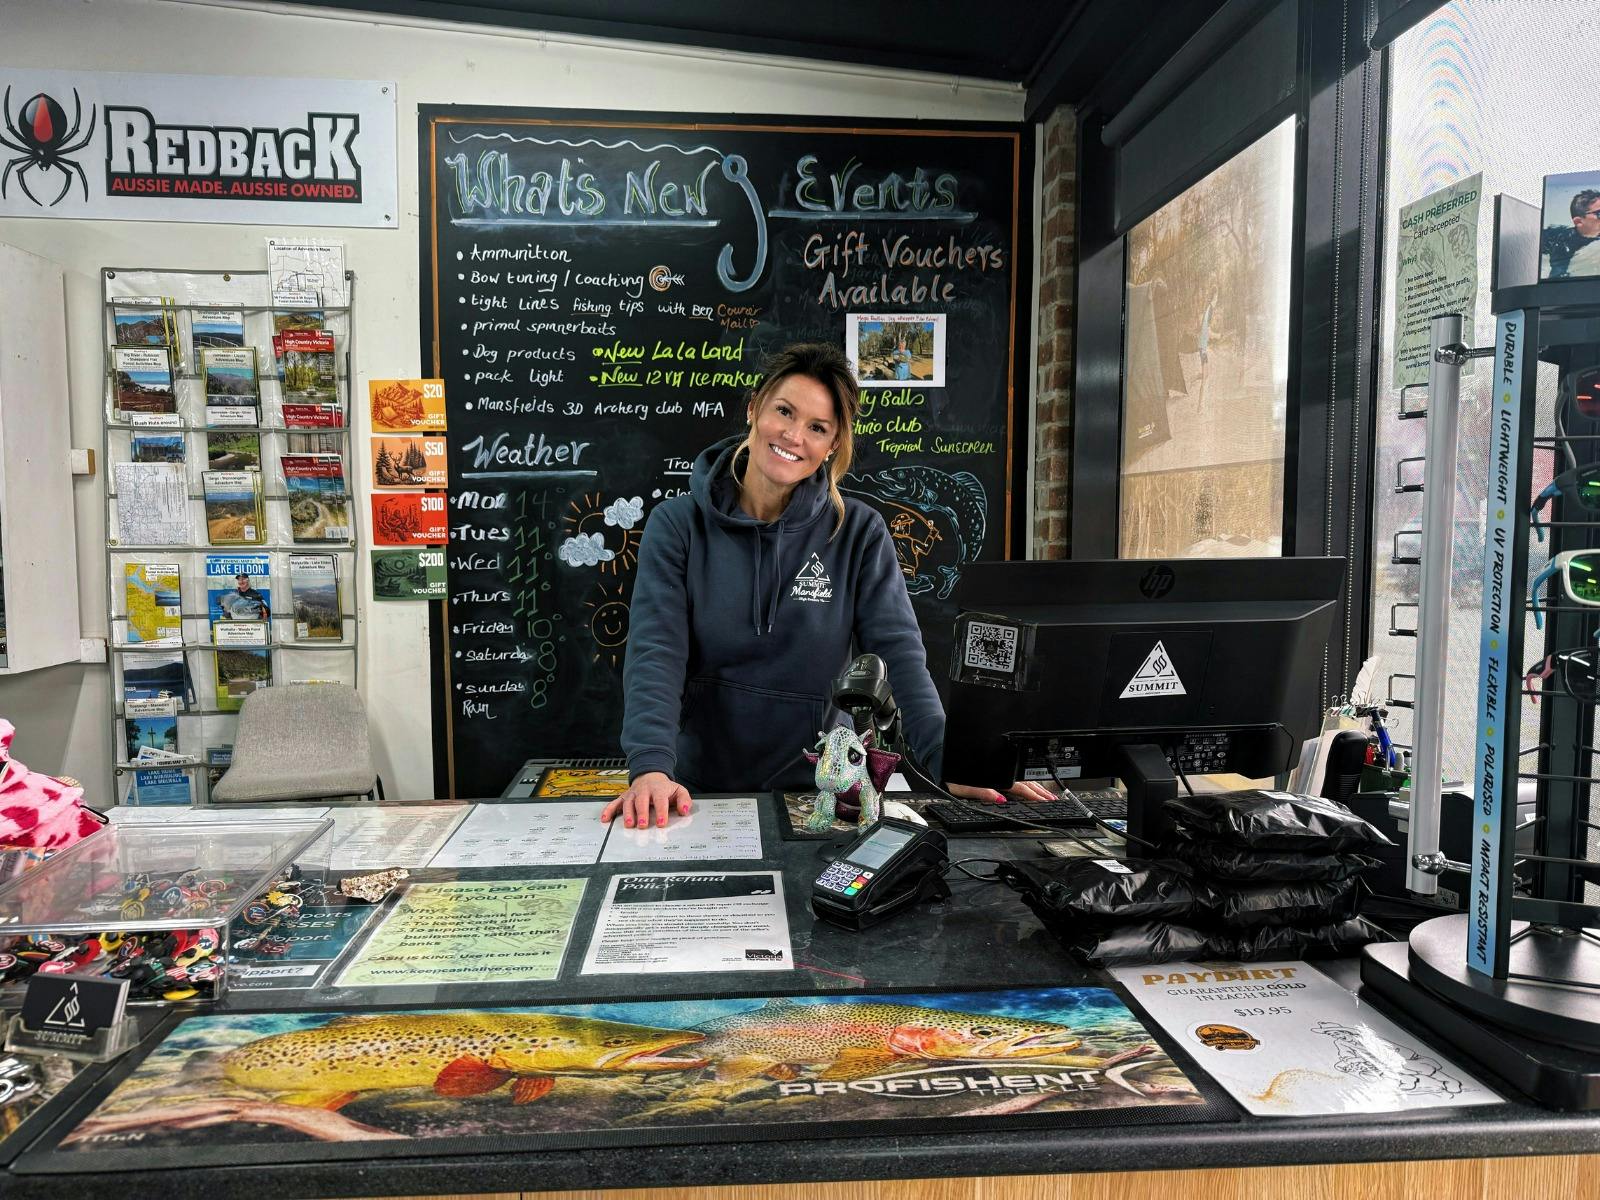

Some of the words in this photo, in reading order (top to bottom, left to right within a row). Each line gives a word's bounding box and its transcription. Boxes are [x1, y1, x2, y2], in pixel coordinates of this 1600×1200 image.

[107, 105, 361, 180] REDBACK
[112, 177, 171, 193] AUSSIE
[174, 179, 228, 195] MADE.
[227, 180, 288, 197] AUSSIE
[290, 182, 359, 199] OWNED.
[444, 150, 606, 216] What's
[624, 160, 720, 216] New
[795, 155, 959, 212] Events
[1402, 213, 1424, 230] CASH
[1424, 190, 1478, 222] PREFERRED
[1413, 225, 1429, 241] Card
[1429, 214, 1461, 234] accepted
[470, 243, 572, 263] Ammunition
[803, 230, 869, 278] Gift
[882, 234, 1005, 271] Vouchers
[470, 270, 500, 284] Bow
[507, 270, 558, 293] tuning
[818, 271, 957, 308] Available
[573, 297, 612, 318] fishing
[619, 299, 644, 318] tips
[658, 302, 686, 317] with
[692, 304, 714, 321] Ben
[473, 319, 521, 337] primal
[527, 321, 617, 336] spinnerbaits
[472, 343, 499, 363] Dog
[506, 347, 576, 363] products
[604, 340, 645, 363] New
[701, 337, 744, 361] Land
[1503, 321, 1517, 386] DURABLE
[475, 369, 514, 385] pack
[601, 366, 638, 385] New
[423, 383, 443, 399] $20
[477, 395, 555, 414] Mansfields
[562, 402, 584, 416] 3D
[594, 401, 649, 421] Archery
[655, 400, 683, 414] club
[692, 401, 725, 418] MFA
[857, 389, 877, 417] lly
[886, 416, 922, 433] club
[424, 441, 444, 457] $50
[461, 432, 591, 470] Weather
[930, 436, 996, 455] Sunscreen
[1497, 408, 1512, 505] LIGHTWEIGHT
[421, 496, 444, 512] $100
[457, 491, 509, 510] Mon
[454, 523, 511, 541] Tues
[1494, 527, 1507, 548] UV
[210, 564, 232, 574] LAKE
[234, 564, 265, 574] EILDON
[418, 552, 444, 568] $200
[456, 552, 501, 571] Wed
[456, 589, 512, 603] Thurs
[790, 585, 833, 600] Mansfield
[1489, 550, 1506, 634] PROTECTION
[462, 620, 514, 634] Friday
[1128, 681, 1179, 693] SUMMIT
[1486, 656, 1499, 722] FLEXIBLE
[1482, 742, 1496, 817] POLARISED
[1479, 838, 1492, 892] IMPACT
[425, 886, 483, 894] Please
[526, 883, 569, 891] cash
[664, 875, 726, 883] Refund
[1476, 892, 1490, 965] RESISTANT
[370, 966, 534, 976] www.keepcashalive.com
[1142, 967, 1298, 986] PAYDIRT
[1167, 984, 1265, 996] GUARANTEED
[1266, 982, 1308, 990] GOLD
[1218, 992, 1258, 1001] EACH
[1260, 990, 1290, 998] BAG
[1234, 1006, 1292, 1018] $19.95
[33, 1030, 86, 1046] SUMMIT
[779, 1069, 1101, 1098] PROFISHENT
[972, 1083, 1101, 1096] TACKLE
